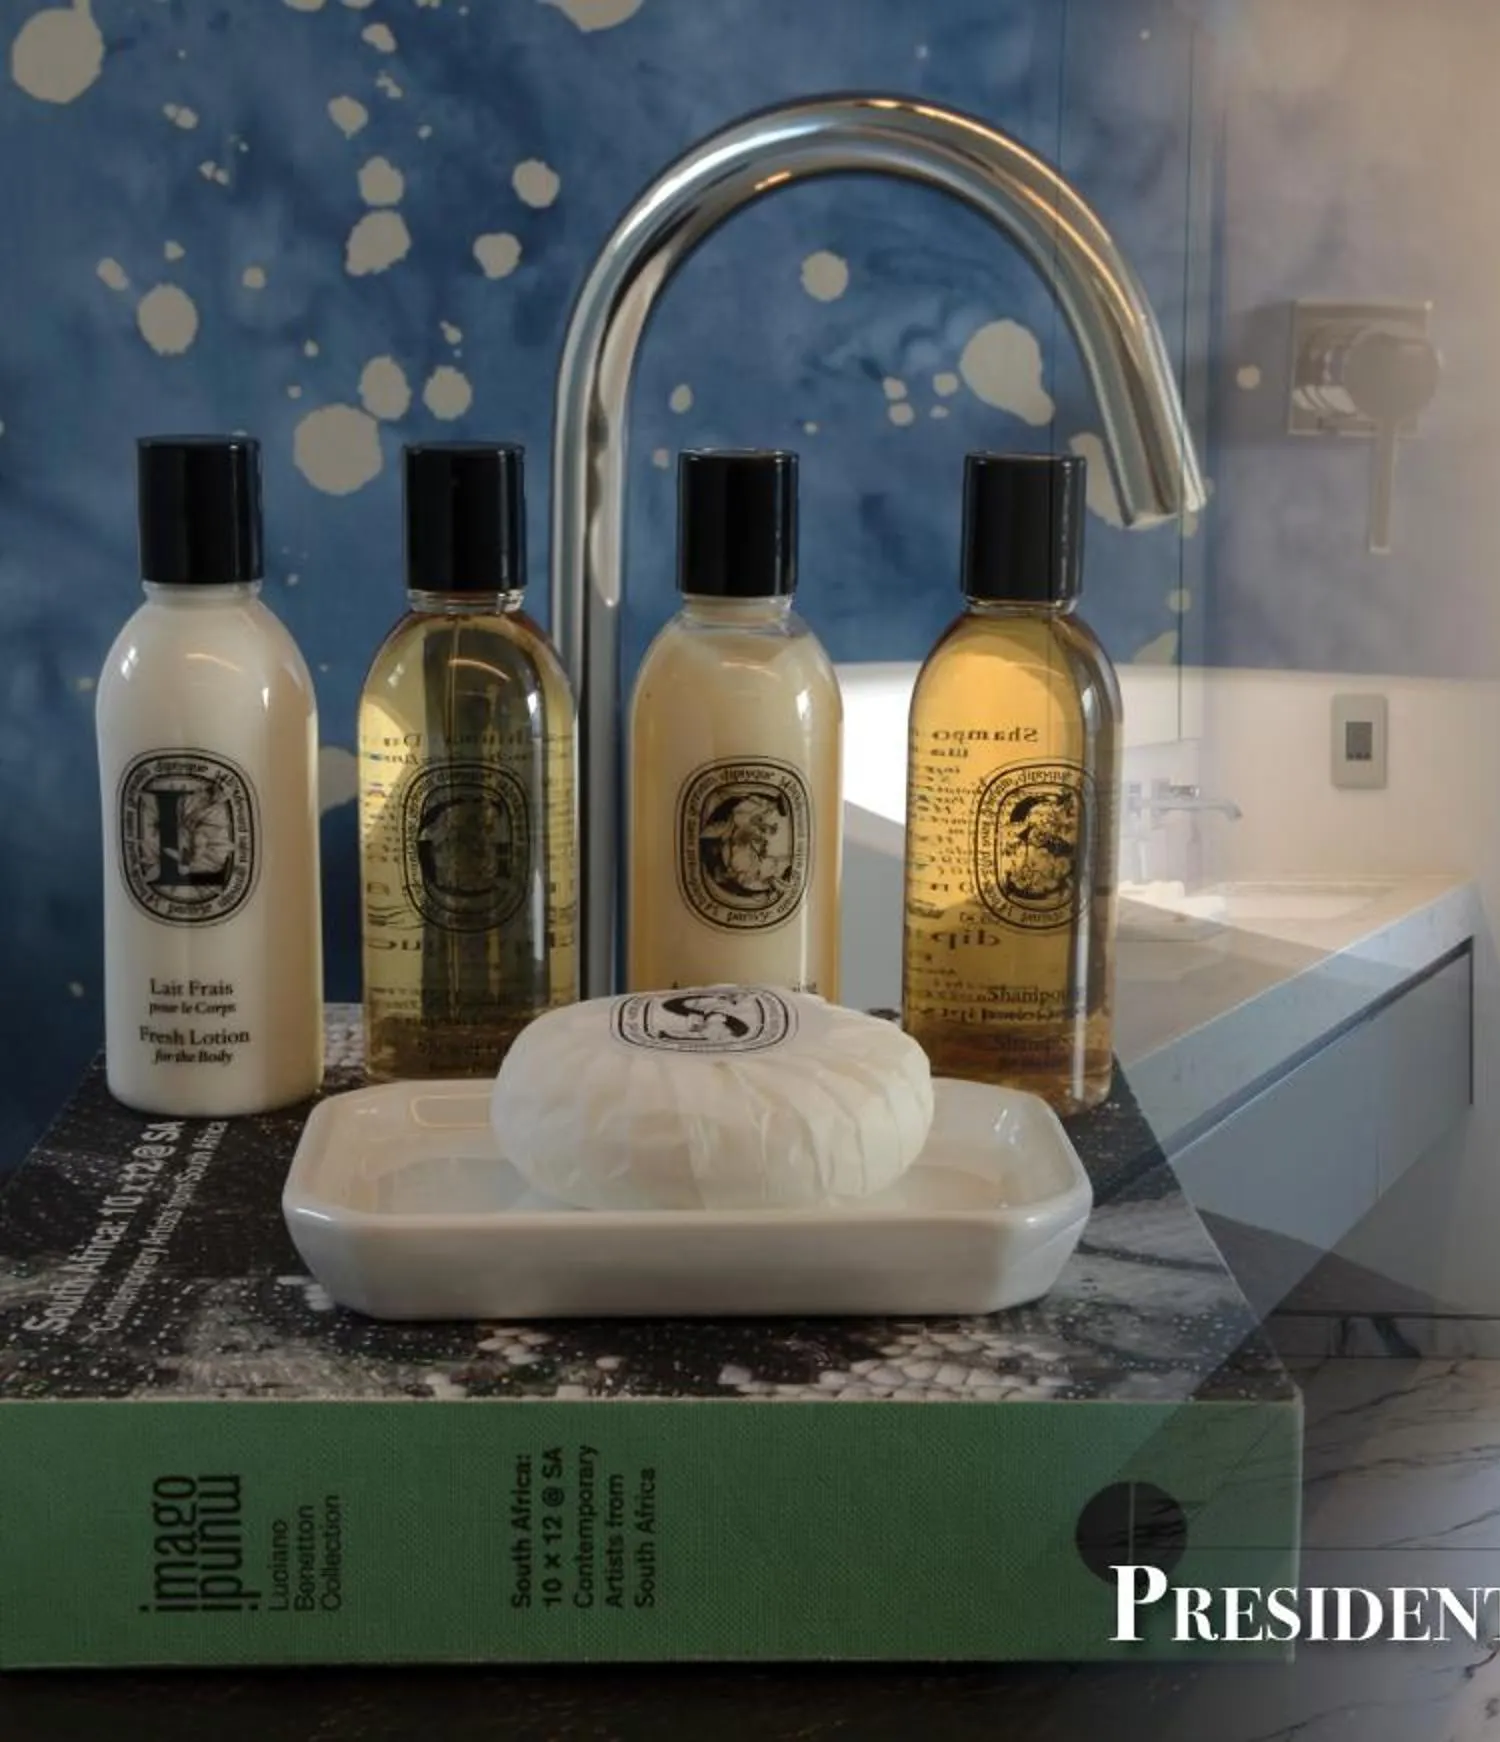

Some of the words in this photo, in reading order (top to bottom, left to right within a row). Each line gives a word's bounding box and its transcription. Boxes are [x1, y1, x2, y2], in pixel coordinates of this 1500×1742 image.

[149, 977, 184, 997] Lait
[188, 979, 234, 997] Frais
[194, 1001, 237, 1018] Corps
[138, 1025, 185, 1046] Fresh
[189, 1028, 250, 1046] Lotion
[198, 1050, 233, 1068] Body
[141, 1121, 186, 1142] SA
[191, 1121, 229, 1150] Africa
[132, 1146, 176, 1159] @
[174, 1151, 215, 1182] South
[118, 1160, 164, 1182] 12
[98, 1195, 143, 1217] 10
[138, 1210, 183, 1246] Artists
[58, 1221, 129, 1275] Africa:
[22, 1277, 97, 1333] South
[541, 1447, 563, 1480] SA
[510, 1454, 532, 1532] Africa:
[541, 1485, 565, 1507] @
[605, 1473, 624, 1528] from
[634, 1467, 656, 1534] Africa
[541, 1515, 563, 1545] 12
[572, 1445, 598, 1608] Contemporary
[138, 1475, 197, 1613] imago
[294, 1504, 315, 1611] Benetton
[321, 1494, 342, 1612] Collection
[268, 1519, 289, 1611] Luciano
[510, 1538, 532, 1609] South
[543, 1553, 561, 1569] x
[605, 1534, 624, 1609] Artists
[634, 1542, 656, 1608] South
[541, 1577, 563, 1608] 10
